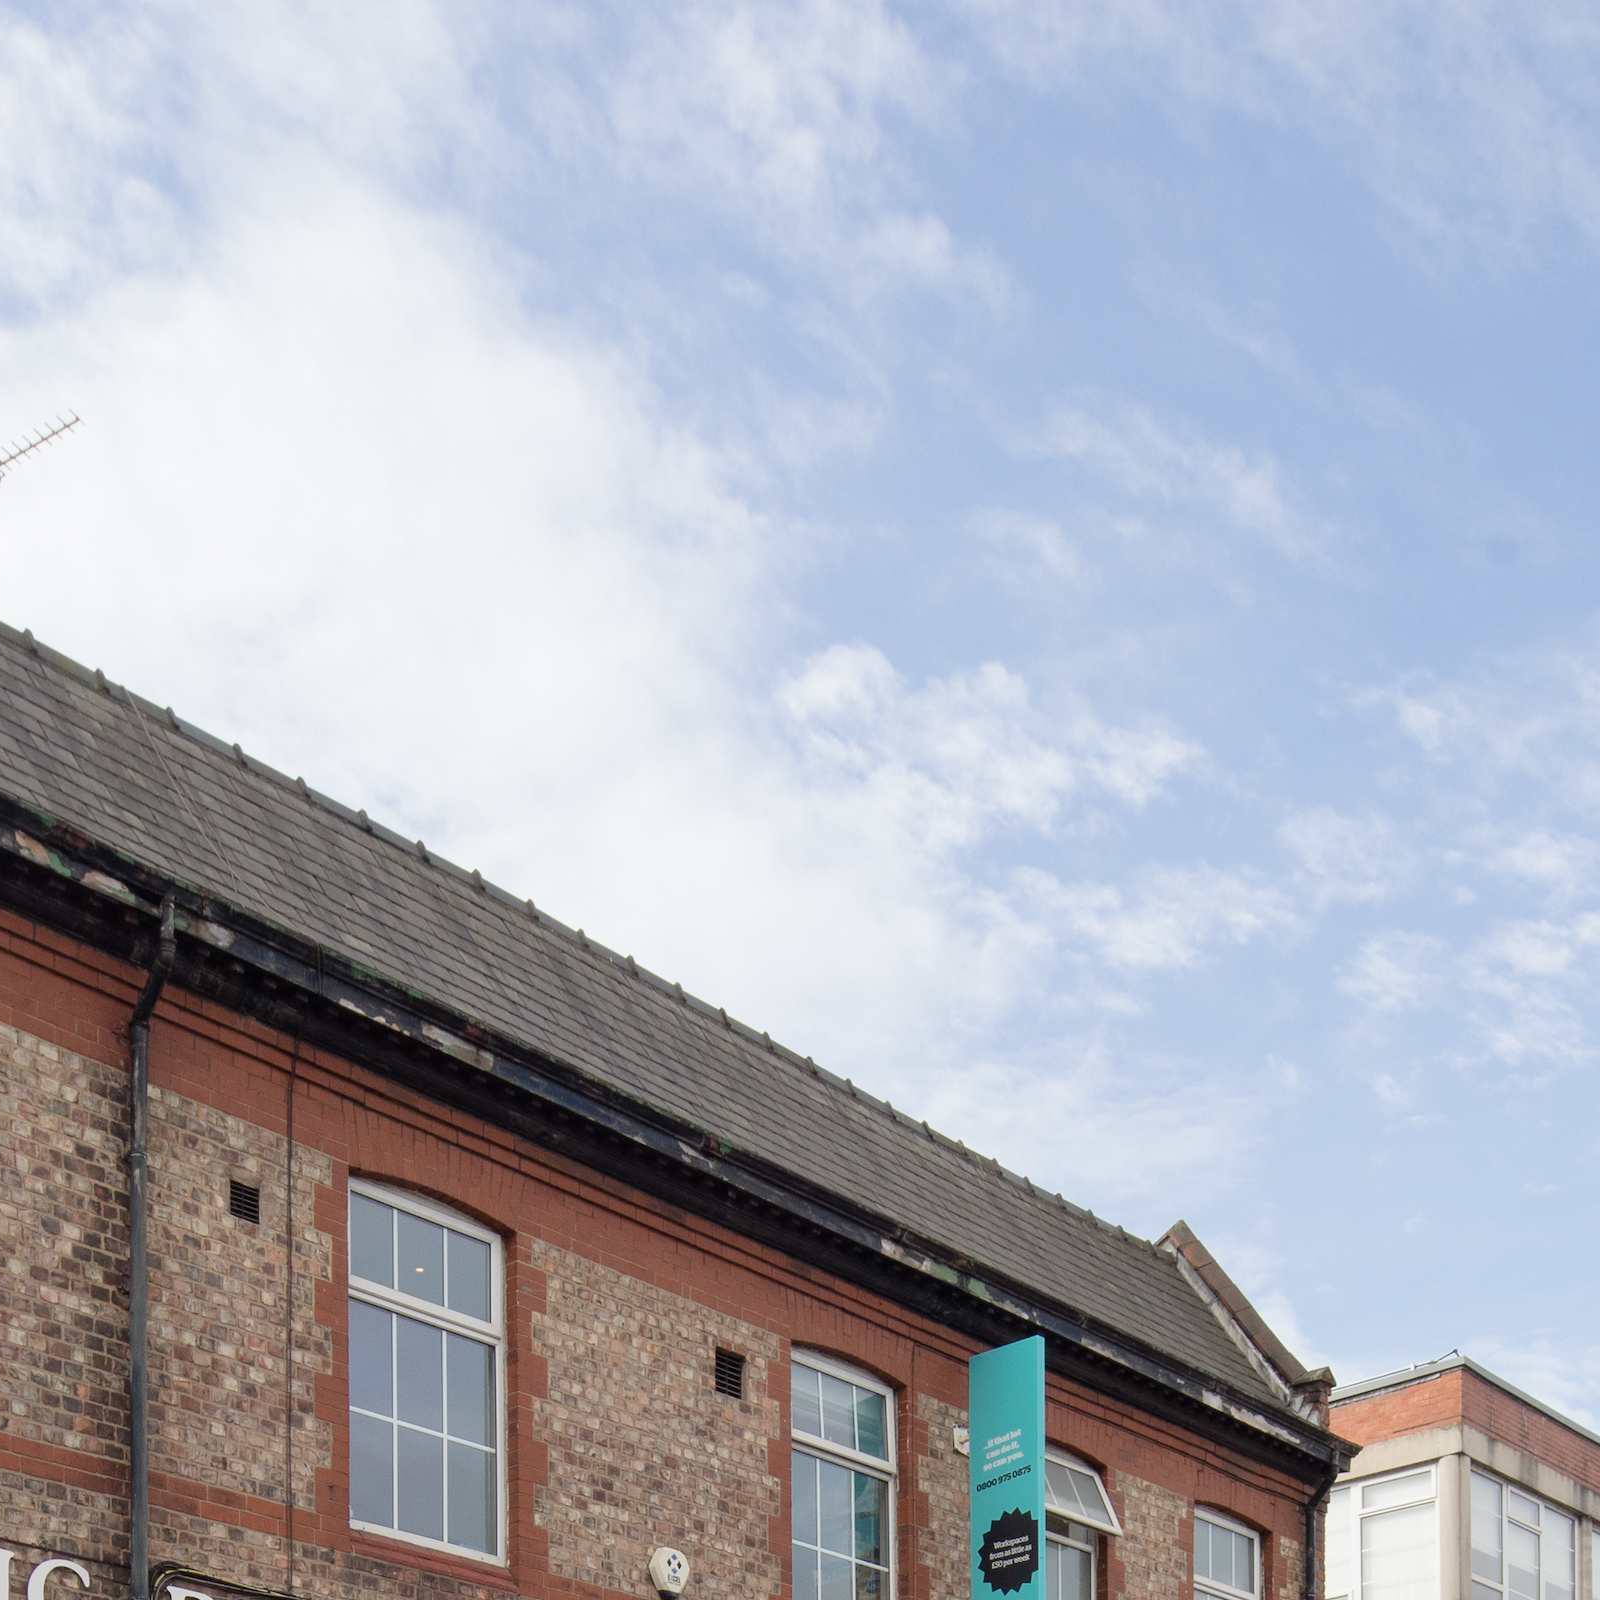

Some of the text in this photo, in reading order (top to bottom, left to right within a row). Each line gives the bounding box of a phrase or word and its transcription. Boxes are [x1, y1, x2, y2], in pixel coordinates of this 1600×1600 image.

[976, 1464, 1031, 1492] 0800 975 0875
